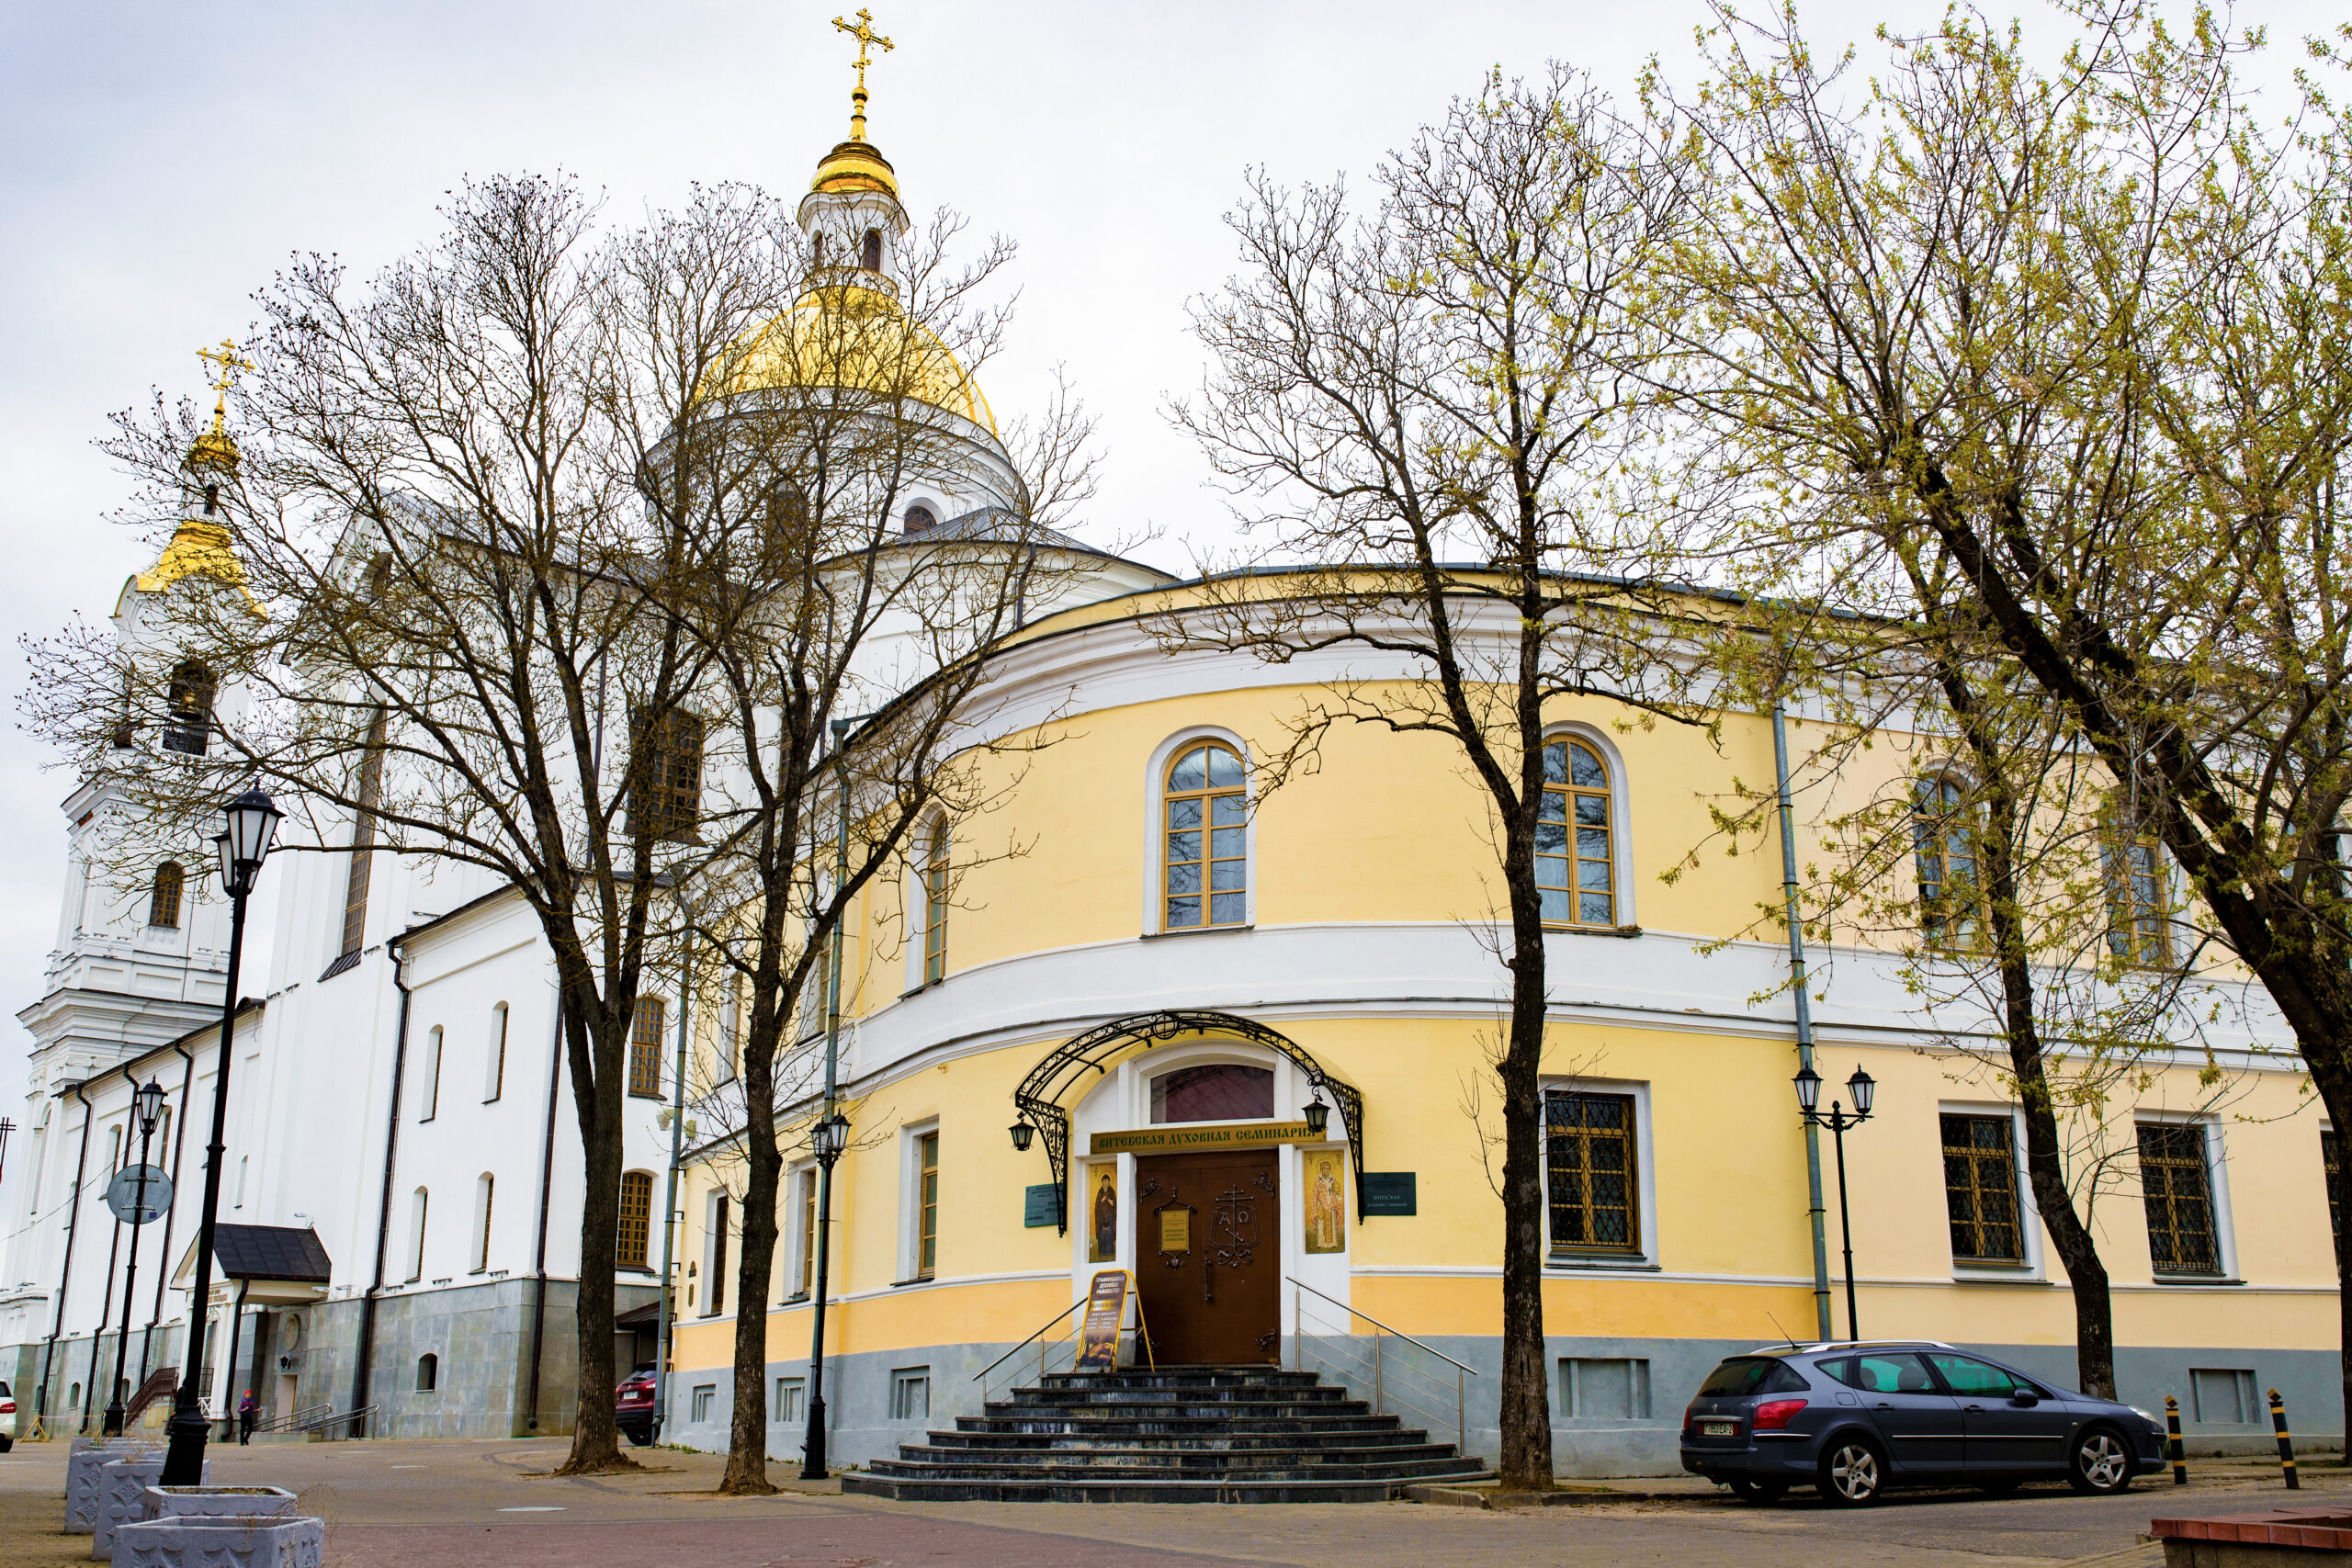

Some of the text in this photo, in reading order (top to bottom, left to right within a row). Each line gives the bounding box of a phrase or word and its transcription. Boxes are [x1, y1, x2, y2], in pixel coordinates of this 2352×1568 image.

[1099, 1127, 1316, 1148] ВИТЕБСКАЯ ДУХОВНАЯ СЕМИНАРИЯ
